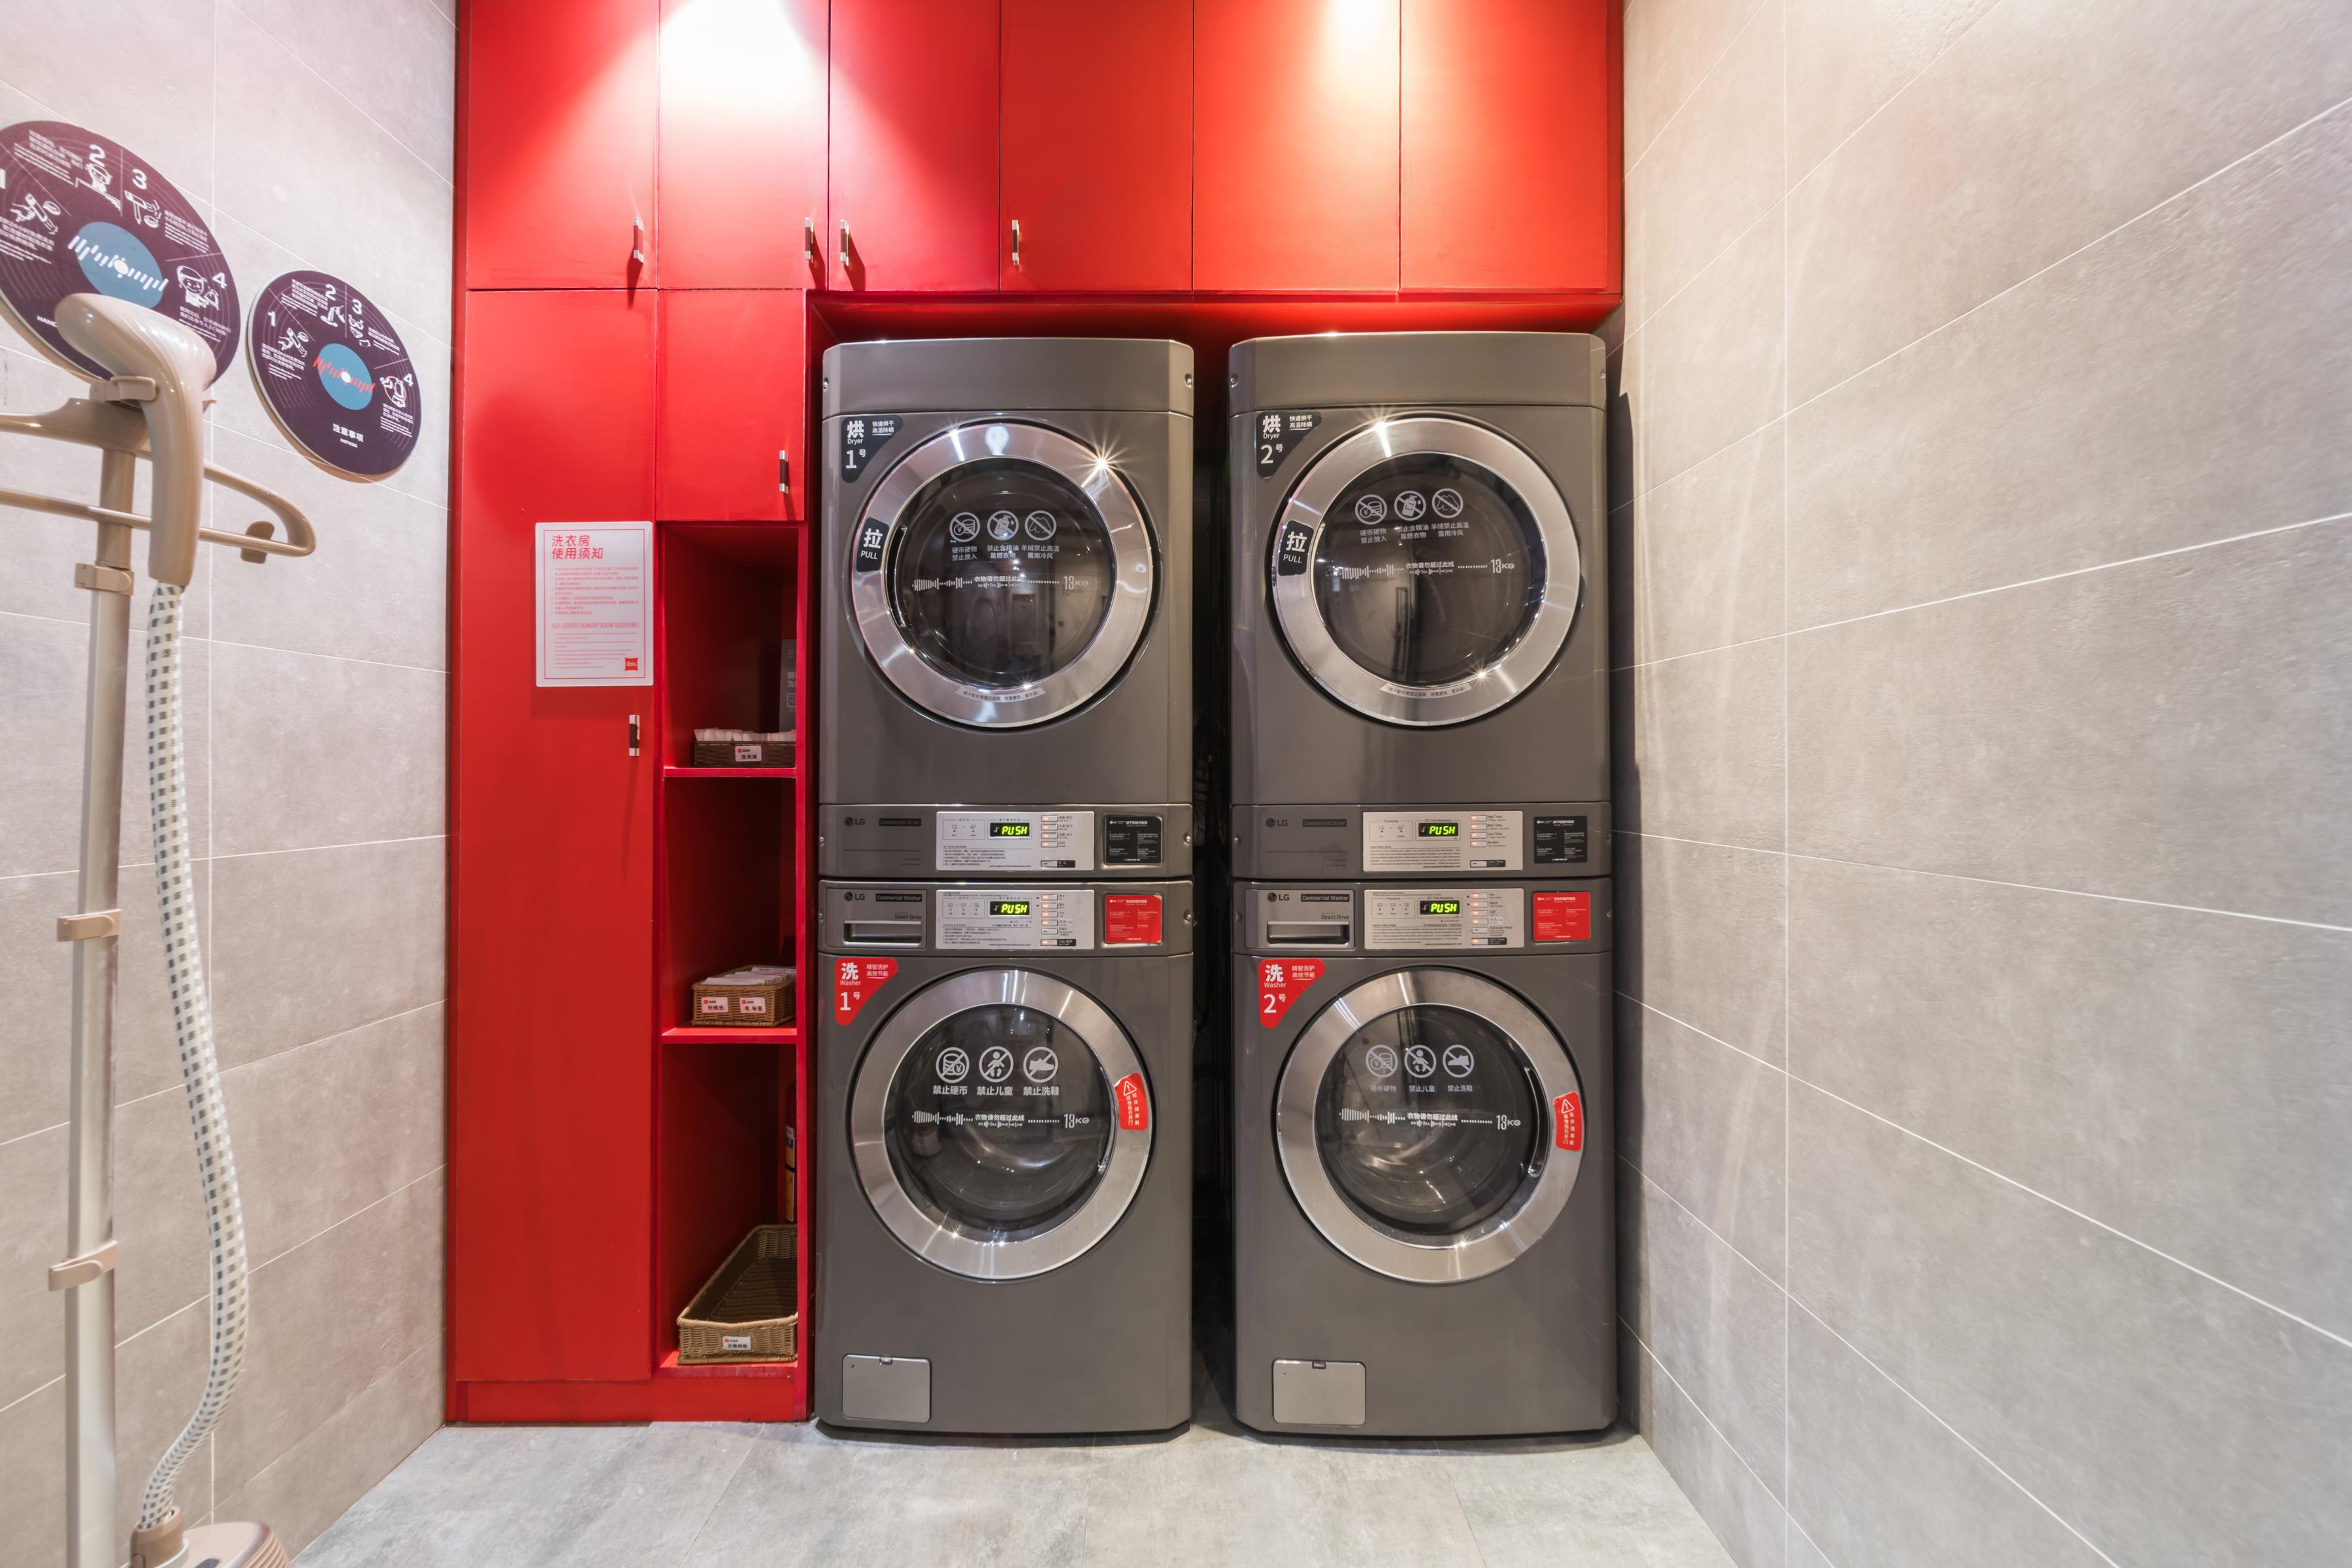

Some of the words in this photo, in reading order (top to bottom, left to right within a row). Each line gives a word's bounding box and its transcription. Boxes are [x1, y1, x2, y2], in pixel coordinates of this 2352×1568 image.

[89, 144, 106, 168] 2
[132, 168, 147, 190] 3
[212, 272, 227, 289] 4
[325, 283, 336, 301] 2
[351, 299, 363, 315] 3
[267, 310, 276, 327] 1
[403, 373, 414, 387] 4
[847, 420, 864, 438] 烘
[1262, 414, 1281, 433] 烘
[551, 535, 590, 547] 洗衣房
[863, 528, 883, 549] 拉
[1286, 531, 1307, 552] 拉
[551, 547, 604, 559] 使用须知
[860, 550, 878, 560] PULL
[1282, 554, 1302, 564] PULL
[1002, 826, 1028, 835] PUSH
[1429, 825, 1456, 835] PUSH
[1001, 904, 1028, 913] PUSH
[1431, 904, 1457, 913] PUSH
[841, 962, 858, 980] 洗
[1265, 964, 1284, 982] 洗
[932, 1085, 968, 1095] 禁止硬币
[977, 1086, 1013, 1096] 禁止儿童
[1023, 1086, 1060, 1096] 禁止洗鞋
[1407, 1112, 1458, 1121] 衣物请勿超过此线
